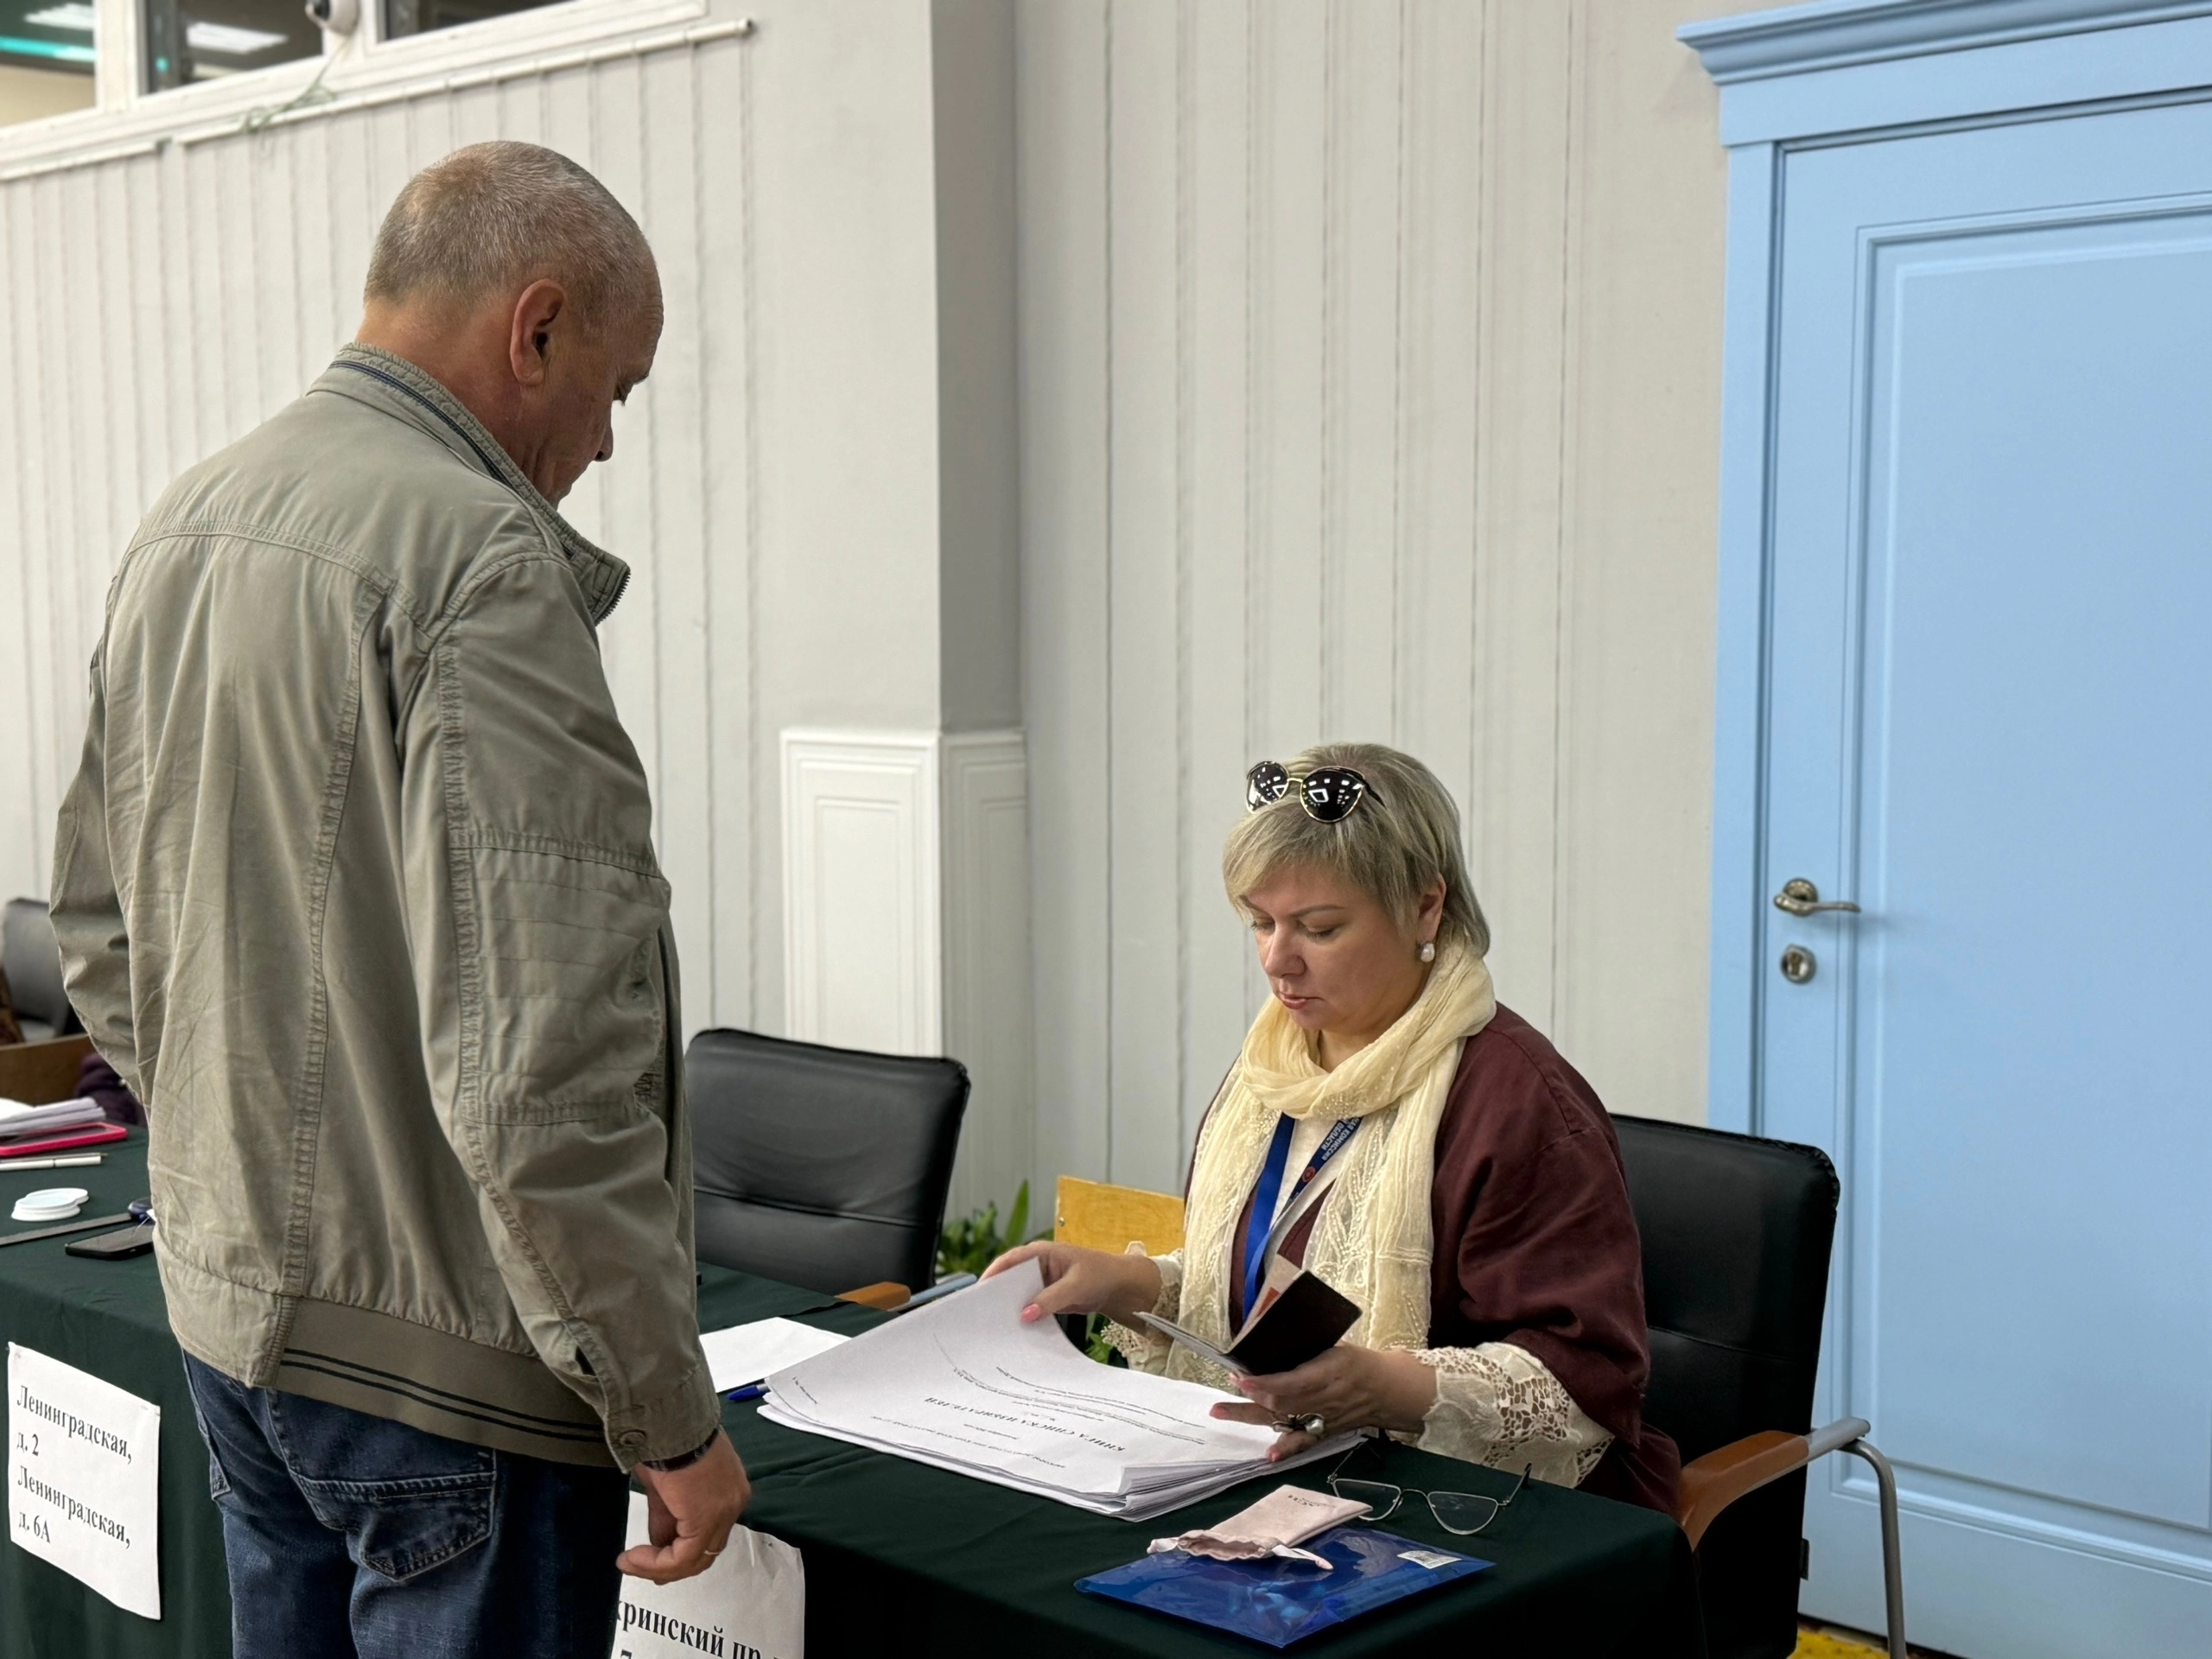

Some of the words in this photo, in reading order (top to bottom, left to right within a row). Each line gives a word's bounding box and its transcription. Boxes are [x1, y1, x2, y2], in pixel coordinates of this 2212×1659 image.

[1321, 1122, 1344, 1150] ОБЛАСТИ
[17, 1385, 132, 1464] Ленинградская,
[16, 1433, 29, 1452] д.
[31, 1433, 40, 1457] 2
[17, 1465, 130, 1548] Ленинградская,
[18, 1511, 30, 1531] д.
[34, 1515, 52, 1544] 6А
